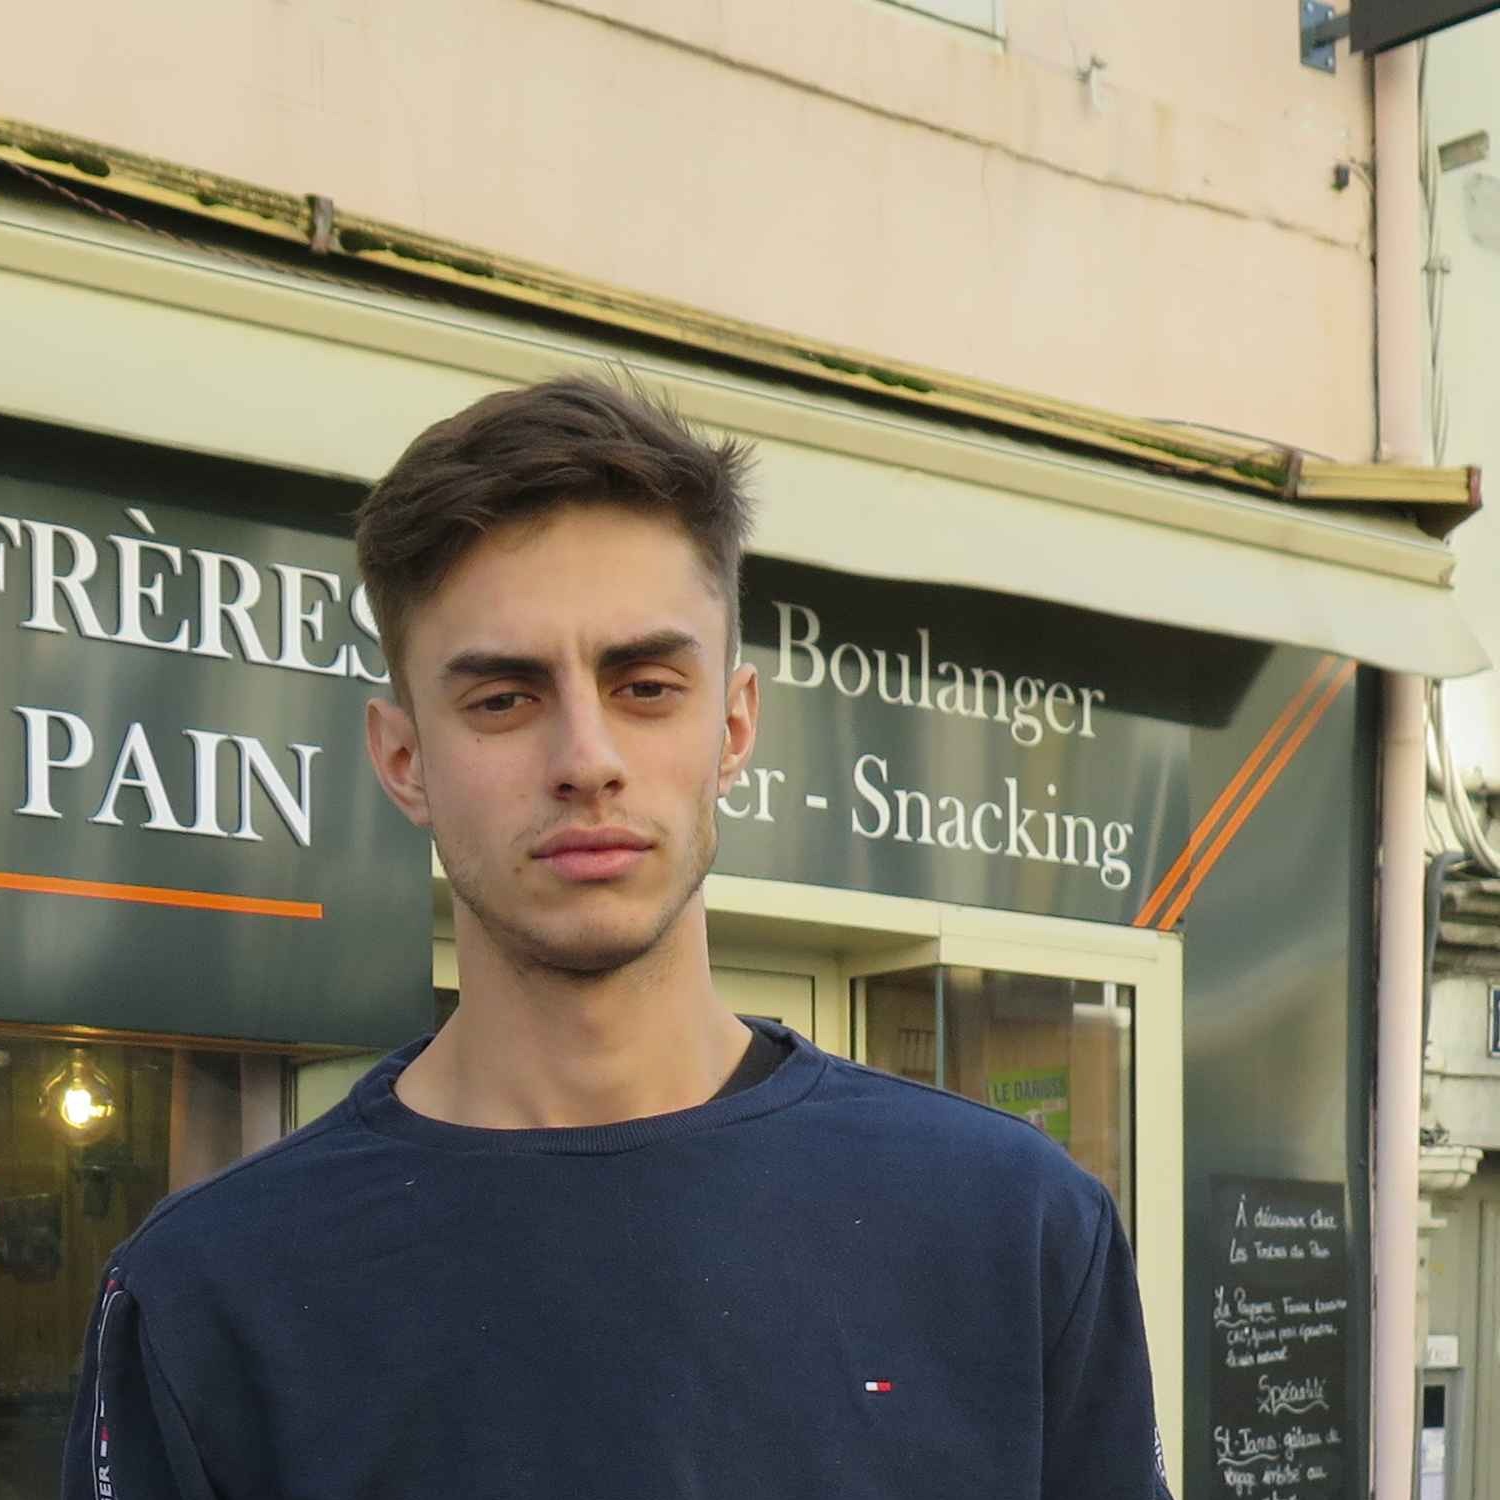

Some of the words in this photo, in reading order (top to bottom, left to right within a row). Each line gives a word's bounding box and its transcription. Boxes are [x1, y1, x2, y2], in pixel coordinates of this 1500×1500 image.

[771, 600, 1106, 748] Boulanger
[12, 704, 324, 847] PAIN
[851, 753, 1134, 891] Snacking
[1230, 1238, 1249, 1264] Les
